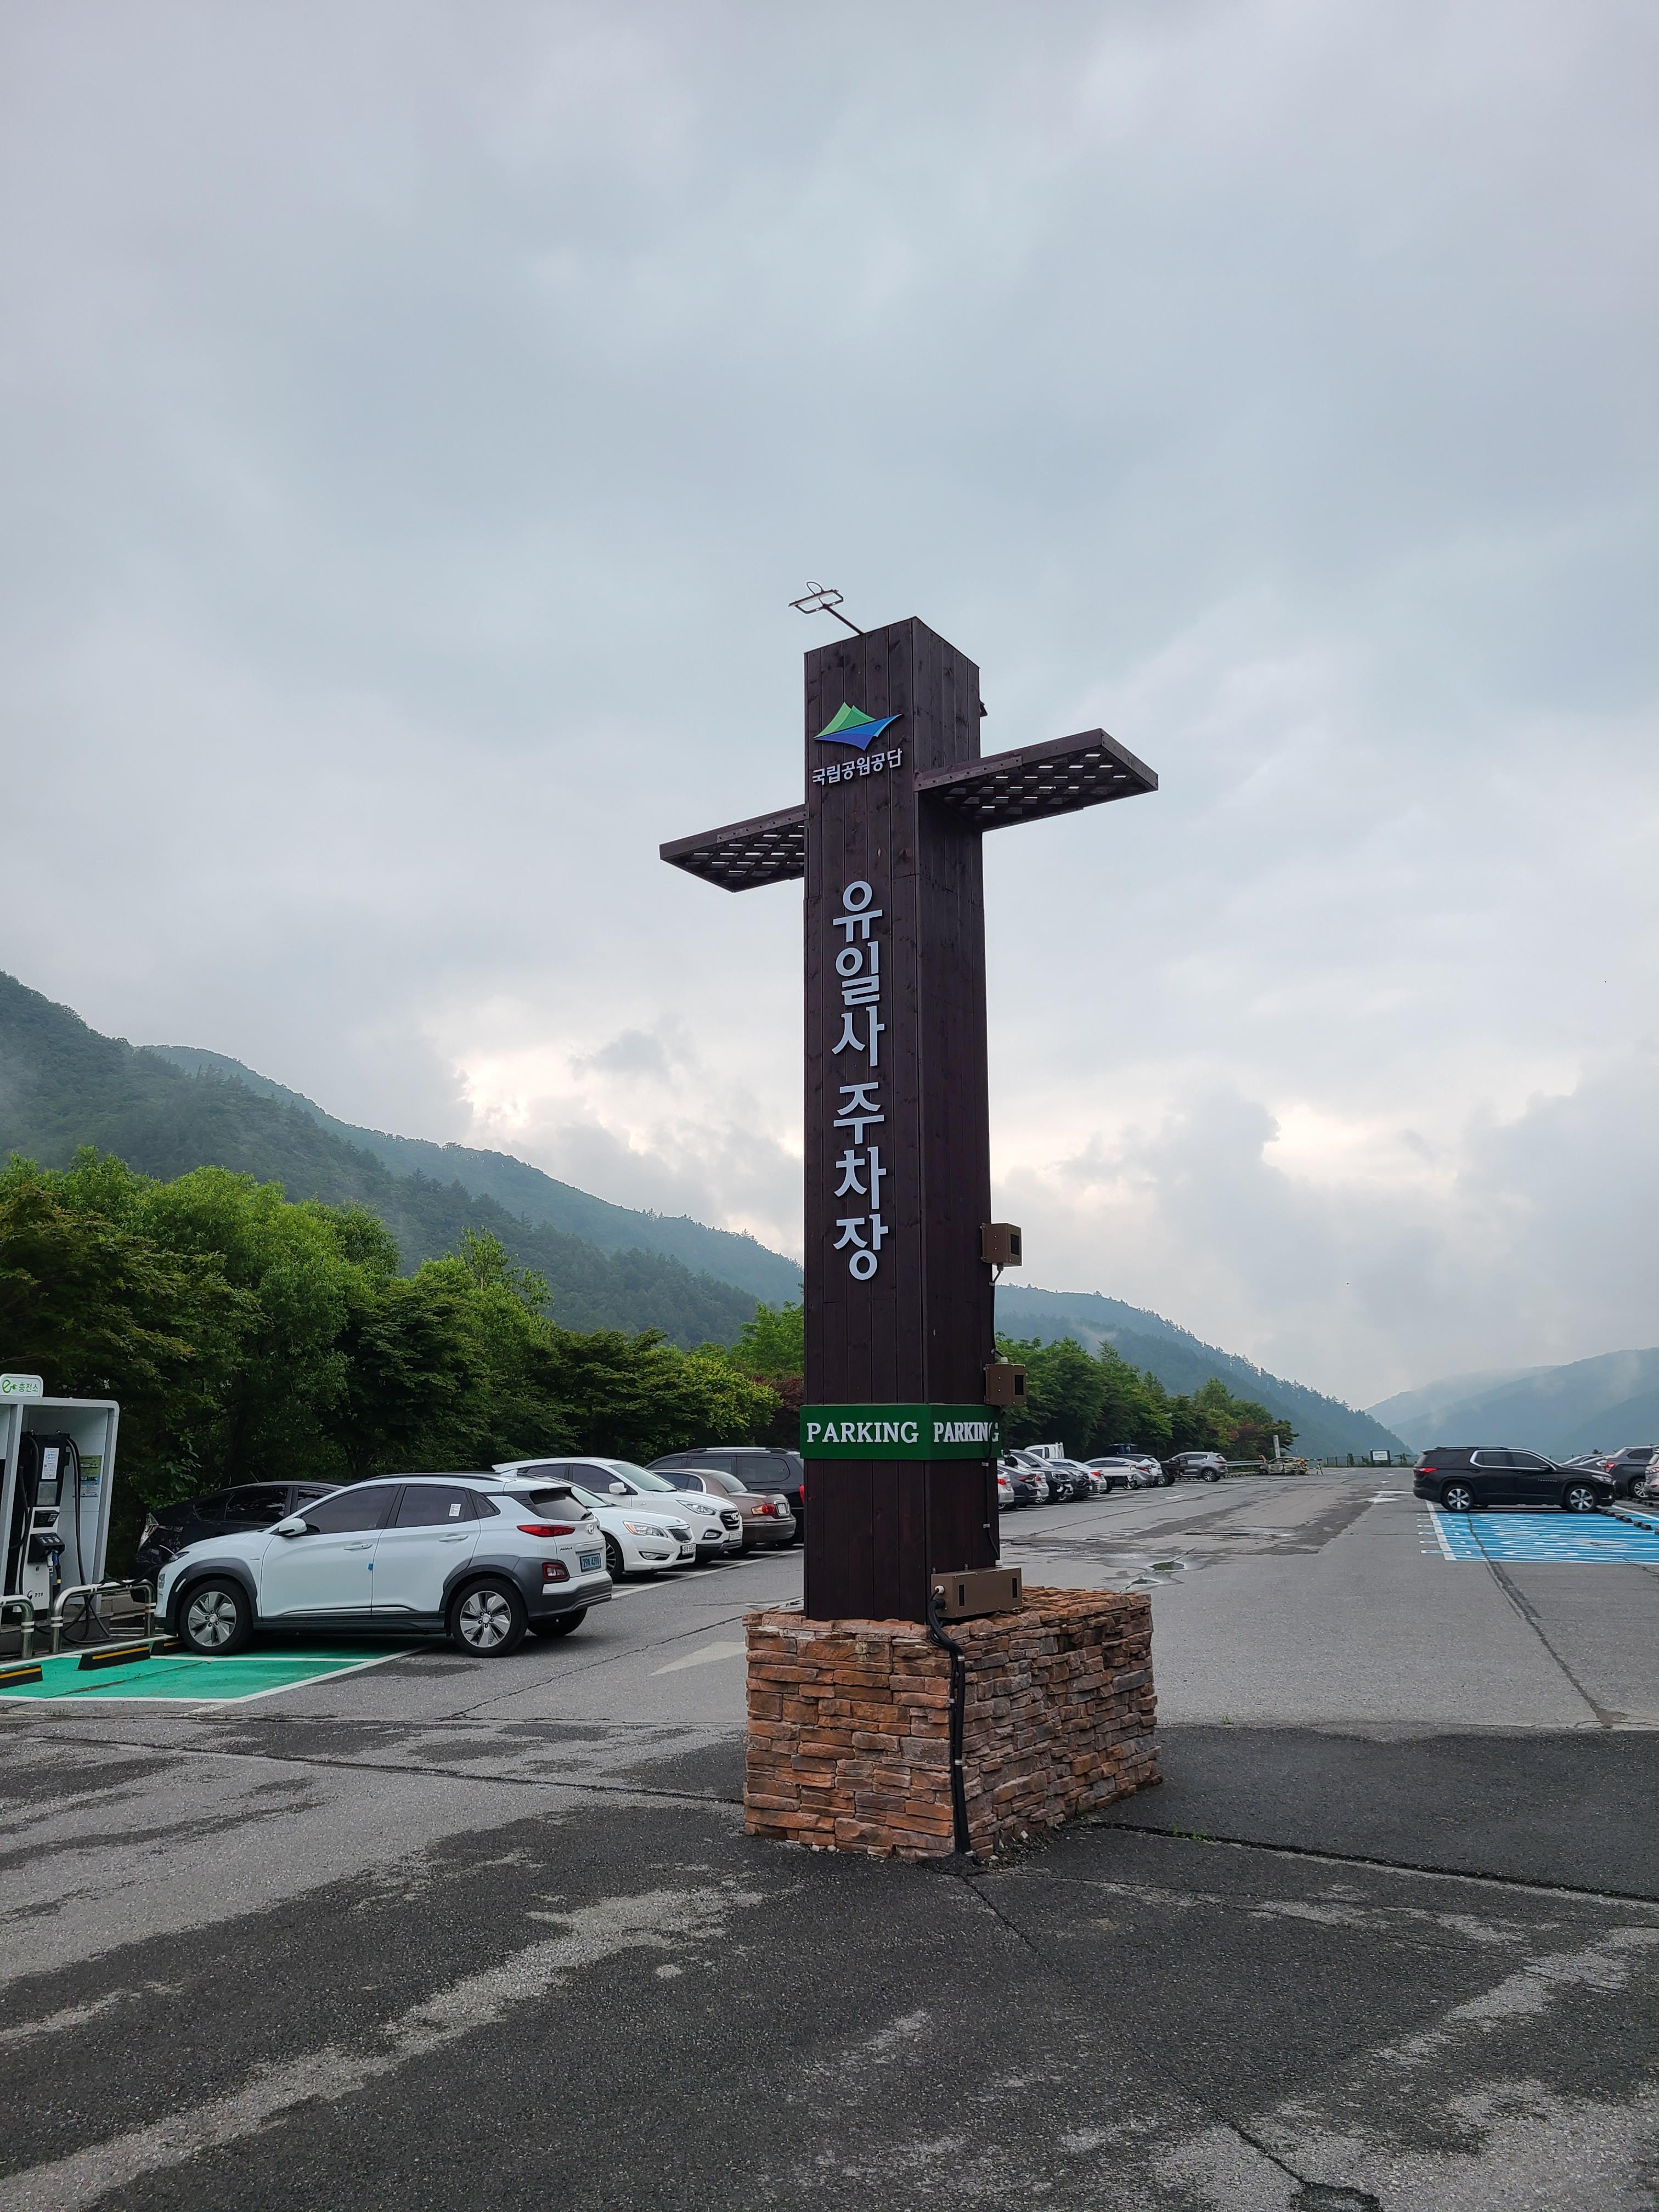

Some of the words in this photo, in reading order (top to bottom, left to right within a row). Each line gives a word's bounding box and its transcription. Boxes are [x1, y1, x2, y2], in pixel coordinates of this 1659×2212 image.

[812, 748, 902, 786] 국립공원공단
[831, 880, 885, 1067] 유일사
[832, 1081, 889, 1280] 주차장
[19, 1382, 38, 1392] 충전소
[806, 1421, 919, 1443] PARKING
[933, 1421, 1000, 1443] PARKING
